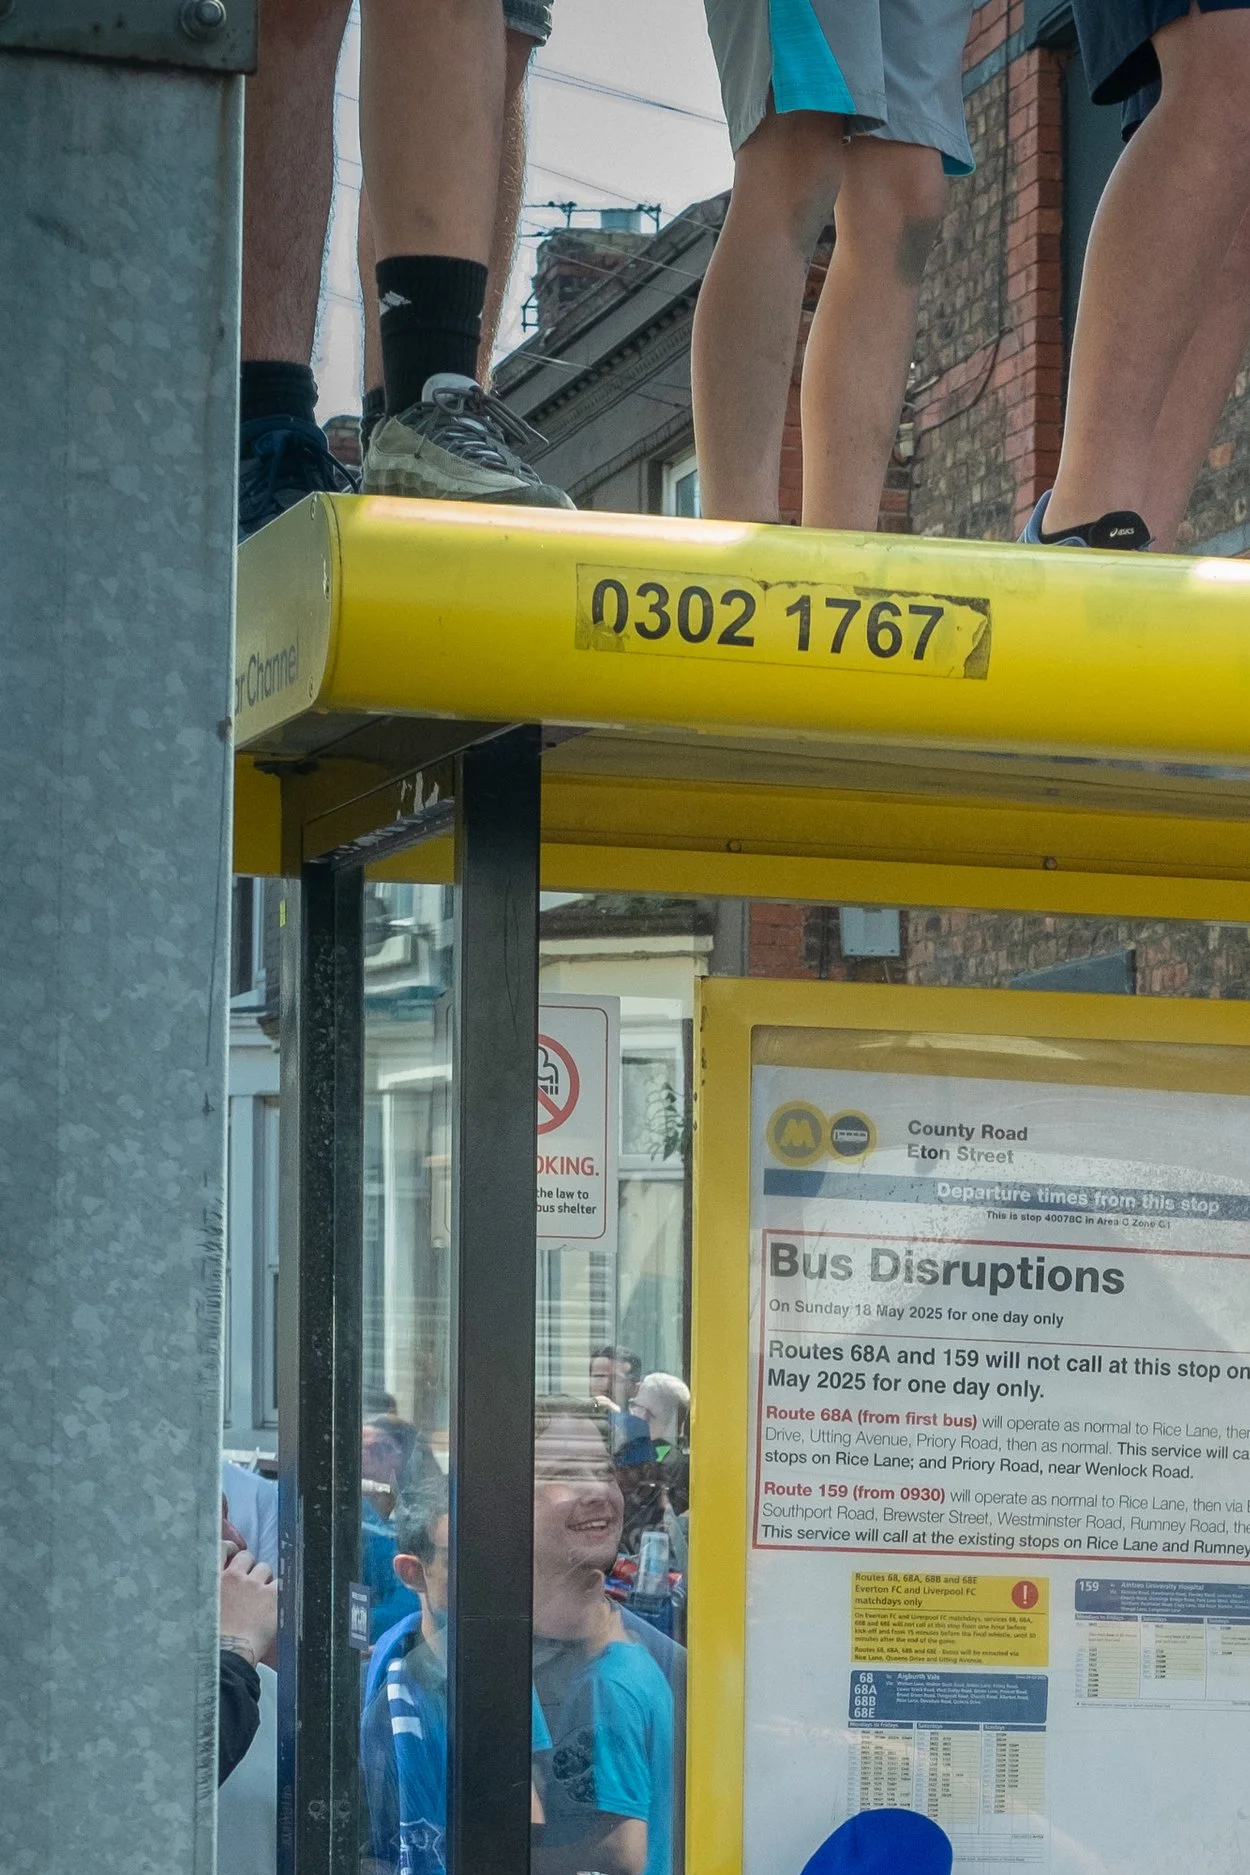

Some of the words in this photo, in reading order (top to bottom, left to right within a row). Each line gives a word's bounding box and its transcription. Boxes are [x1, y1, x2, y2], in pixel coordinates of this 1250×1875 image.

[591, 579, 756, 647] 0302
[785, 593, 945, 661] 1767
[247, 633, 300, 708] Channel
[907, 1119, 975, 1141] County
[981, 1123, 1028, 1141] Road
[907, 1143, 950, 1160] Eton
[957, 1145, 1013, 1164] Street
[556, 1187, 574, 1199] law
[577, 1190, 589, 1199] to
[937, 1182, 1031, 1202] Departure
[1037, 1187, 1089, 1205] times
[1094, 1191, 1136, 1209] from
[1142, 1193, 1174, 1210] this
[1180, 1197, 1220, 1216] stop
[557, 1202, 598, 1214] shelter
[1020, 1212, 1042, 1223] stop
[770, 1242, 852, 1281] Bus
[870, 1247, 1124, 1295] Disruptions
[768, 1299, 790, 1312] On
[794, 1300, 849, 1318] Sunday
[855, 1303, 871, 1316] 18
[876, 1304, 904, 1320] May
[909, 1305, 942, 1320] 2025
[947, 1307, 967, 1321] for
[971, 1311, 998, 1322] one
[1002, 1310, 1028, 1327] day
[1033, 1311, 1064, 1328] only
[768, 1340, 843, 1361] Routes
[850, 1344, 890, 1363] 68A
[896, 1346, 935, 1365] and
[943, 1348, 979, 1367] 159
[985, 1350, 1020, 1369] will
[1027, 1353, 1060, 1371] not
[1066, 1354, 1102, 1373] call
[1108, 1356, 1127, 1374] at
[1134, 1357, 1171, 1376] this
[1177, 1360, 1220, 1382] stop
[1226, 1365, 1250, 1380] on
[767, 1370, 810, 1392] May
[816, 1372, 866, 1390] 2025
[872, 1374, 902, 1392] for
[907, 1378, 946, 1394] one
[952, 1377, 990, 1399] day
[996, 1379, 1044, 1401] only.
[766, 1406, 815, 1421] Route
[820, 1409, 853, 1422] 68A
[857, 1410, 900, 1427] (from
[904, 1412, 938, 1426] first
[942, 1413, 977, 1431] bus)
[981, 1415, 1002, 1429] will
[1006, 1417, 1060, 1433] operate
[1063, 1420, 1080, 1432] as
[1083, 1419, 1131, 1434] normal
[1135, 1422, 1149, 1435] to
[1152, 1422, 1181, 1437] Rice
[1185, 1423, 1221, 1439] Lane,
[766, 1428, 804, 1444] Drive,
[809, 1430, 851, 1447] Utting
[855, 1432, 911, 1447] Avenue,
[916, 1434, 956, 1451] Priory
[960, 1436, 1001, 1451] Road,
[1007, 1438, 1037, 1452] then
[1040, 1441, 1057, 1453] as
[1061, 1441, 1112, 1455] normal.
[1119, 1442, 1147, 1456] This
[1151, 1443, 1202, 1458] service
[1205, 1446, 1228, 1459] will
[764, 1451, 807, 1466] stops
[811, 1453, 831, 1465] on
[835, 1453, 869, 1466] Rice
[873, 1455, 914, 1470] Lane;
[918, 1456, 947, 1469] and
[951, 1457, 995, 1474] Priory
[999, 1459, 1043, 1475] Road,
[1048, 1462, 1081, 1475] near
[1085, 1462, 1148, 1477] Wenlock
[1152, 1464, 1193, 1479] Road.
[1079, 1581, 1100, 1592] 159
[854, 1684, 877, 1695] 68A
[860, 1672, 873, 1683] 68
[854, 1696, 876, 1707] 68B
[854, 1707, 875, 1718] 68E
